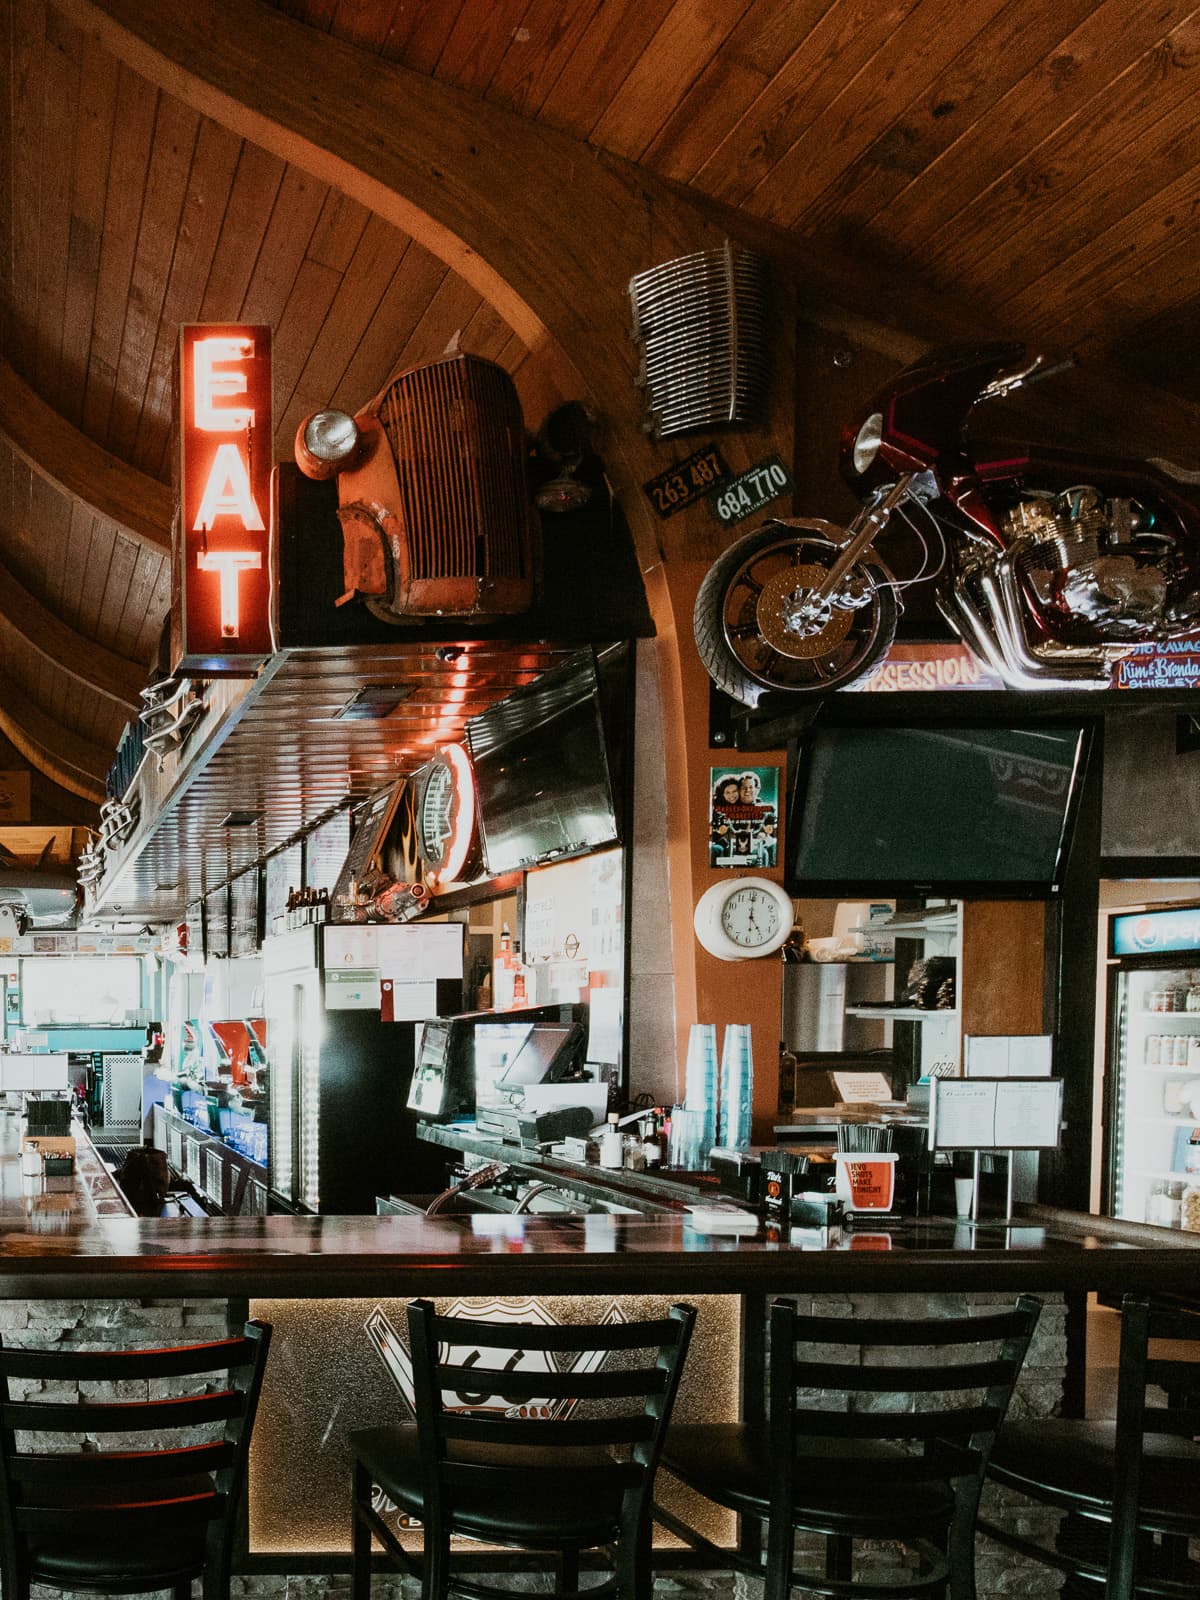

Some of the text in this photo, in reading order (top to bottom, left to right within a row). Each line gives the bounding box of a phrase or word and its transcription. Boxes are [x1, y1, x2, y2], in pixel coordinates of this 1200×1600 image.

[193, 338, 266, 638] EAT
[653, 453, 722, 511] 263 487
[717, 464, 787, 519] 684 770
[1154, 658, 1200, 678] Brenda
[851, 1170, 873, 1178] SHOTS
[853, 1178, 871, 1186] MAKE
